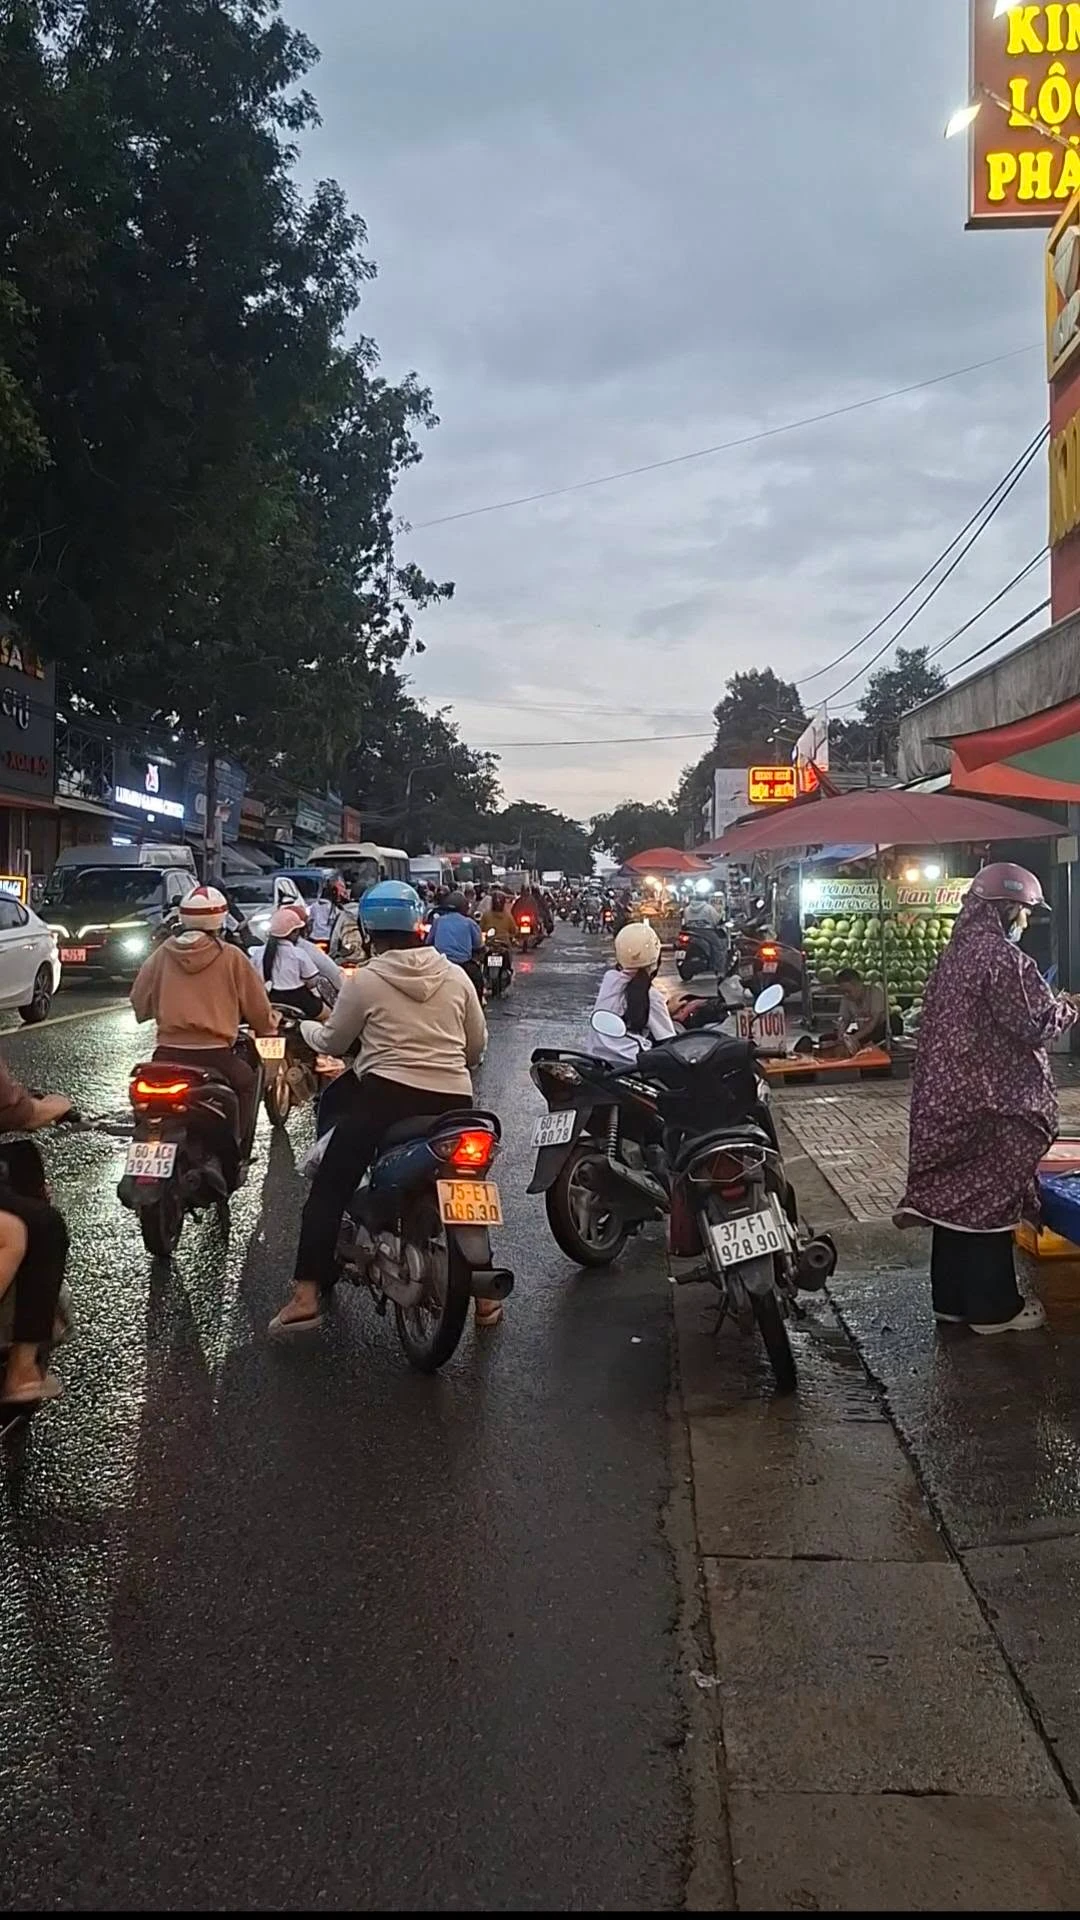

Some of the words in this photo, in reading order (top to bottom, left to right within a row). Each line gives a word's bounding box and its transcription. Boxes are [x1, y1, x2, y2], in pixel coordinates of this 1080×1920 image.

[1008, 61, 1080, 135] LỘ
[541, 1114, 568, 1130] 60-F1
[128, 1160, 171, 1175] 392.15
[447, 1183, 489, 1201] 75-E1
[444, 1203, 499, 1221] 086.30
[721, 1214, 766, 1241] 37-F1
[721, 1231, 778, 1262] 928.90
